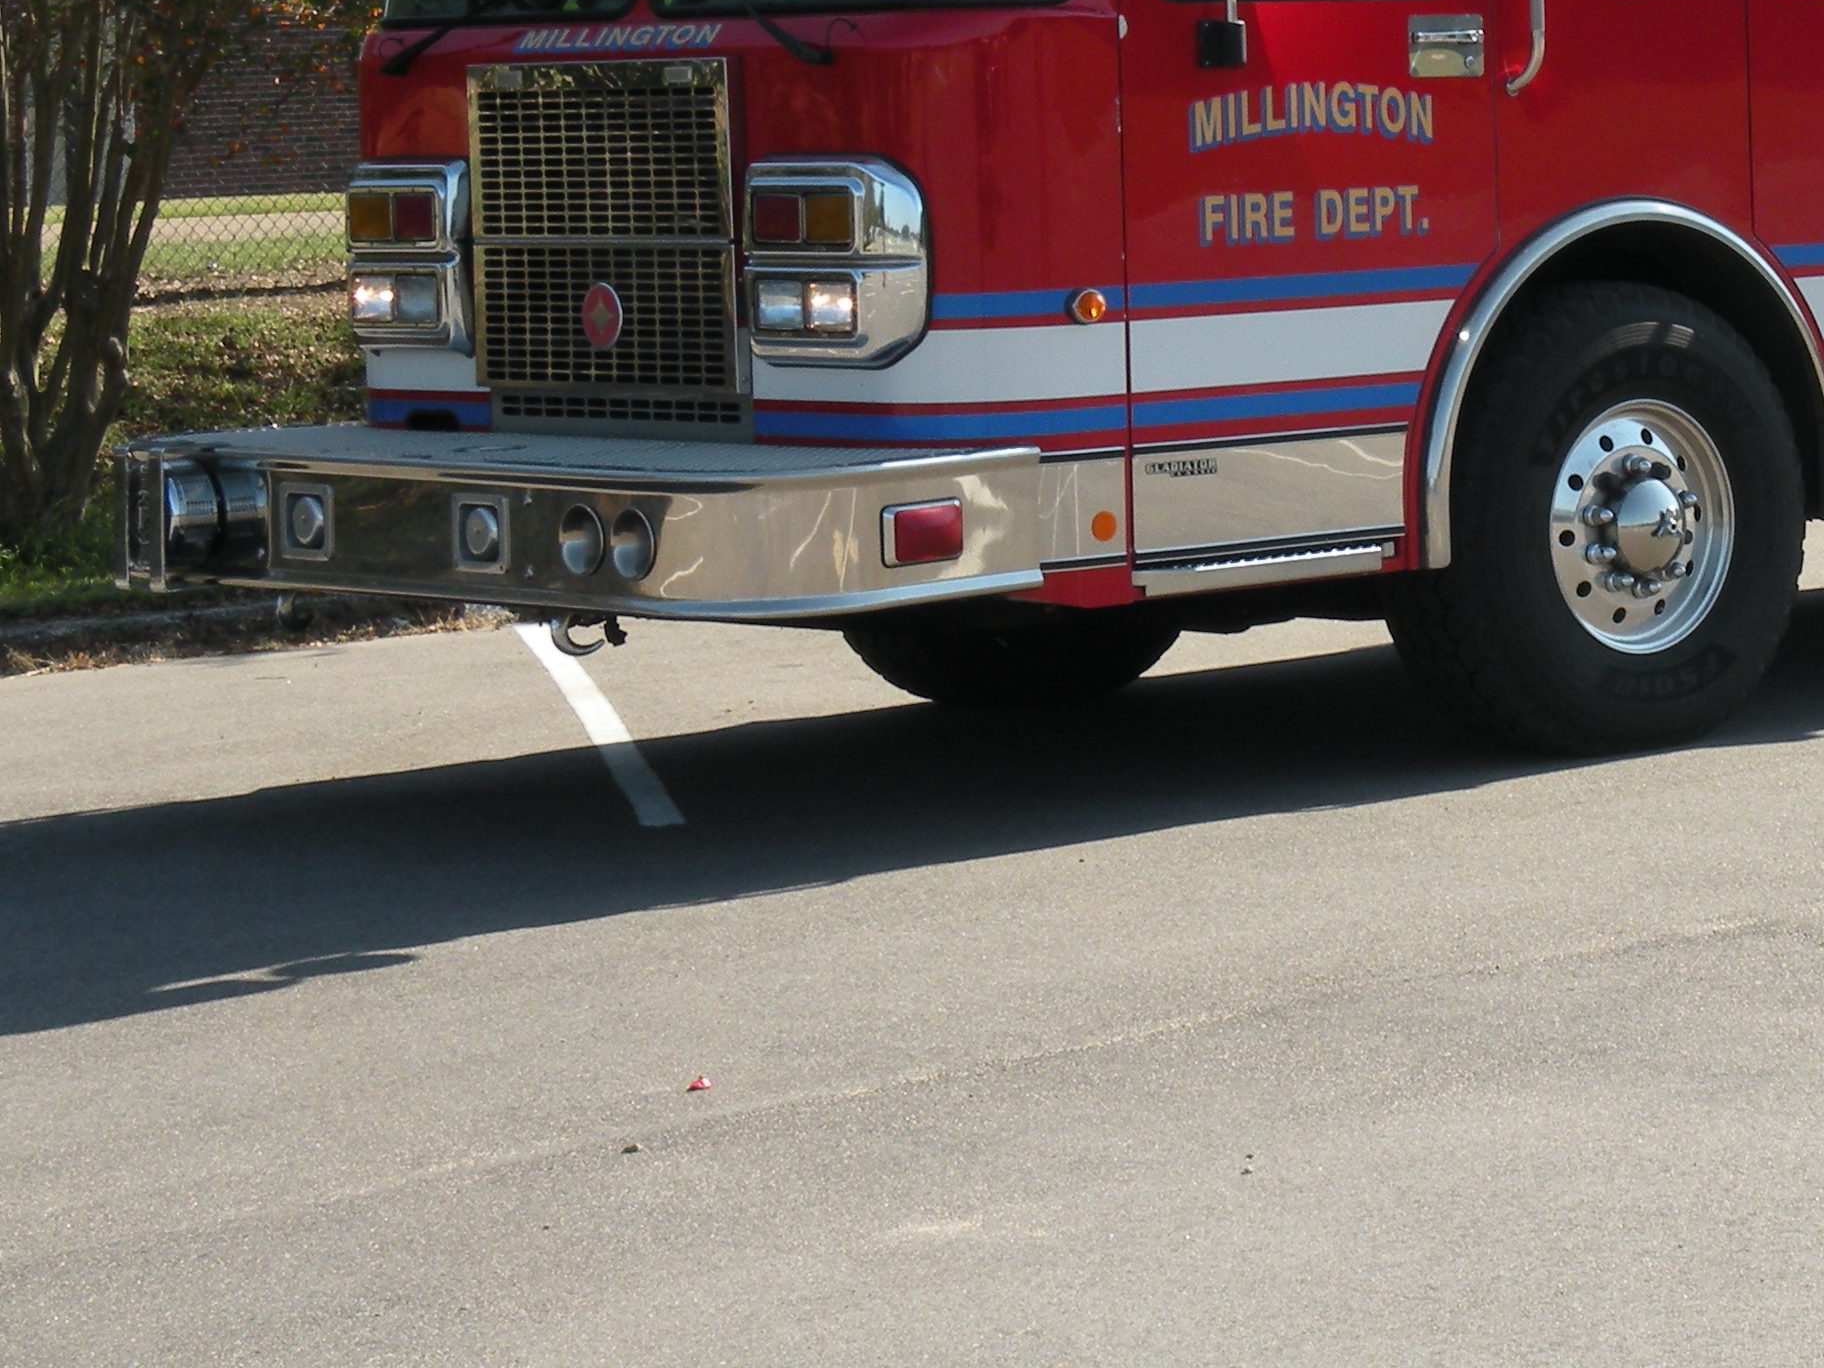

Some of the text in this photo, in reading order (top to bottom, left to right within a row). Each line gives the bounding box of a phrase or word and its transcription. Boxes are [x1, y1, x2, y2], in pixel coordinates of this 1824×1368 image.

[513, 23, 721, 54] MILLINGTON
[1190, 81, 1433, 153] MILLINGTON
[1200, 185, 1429, 247] FIRE DEPT.
